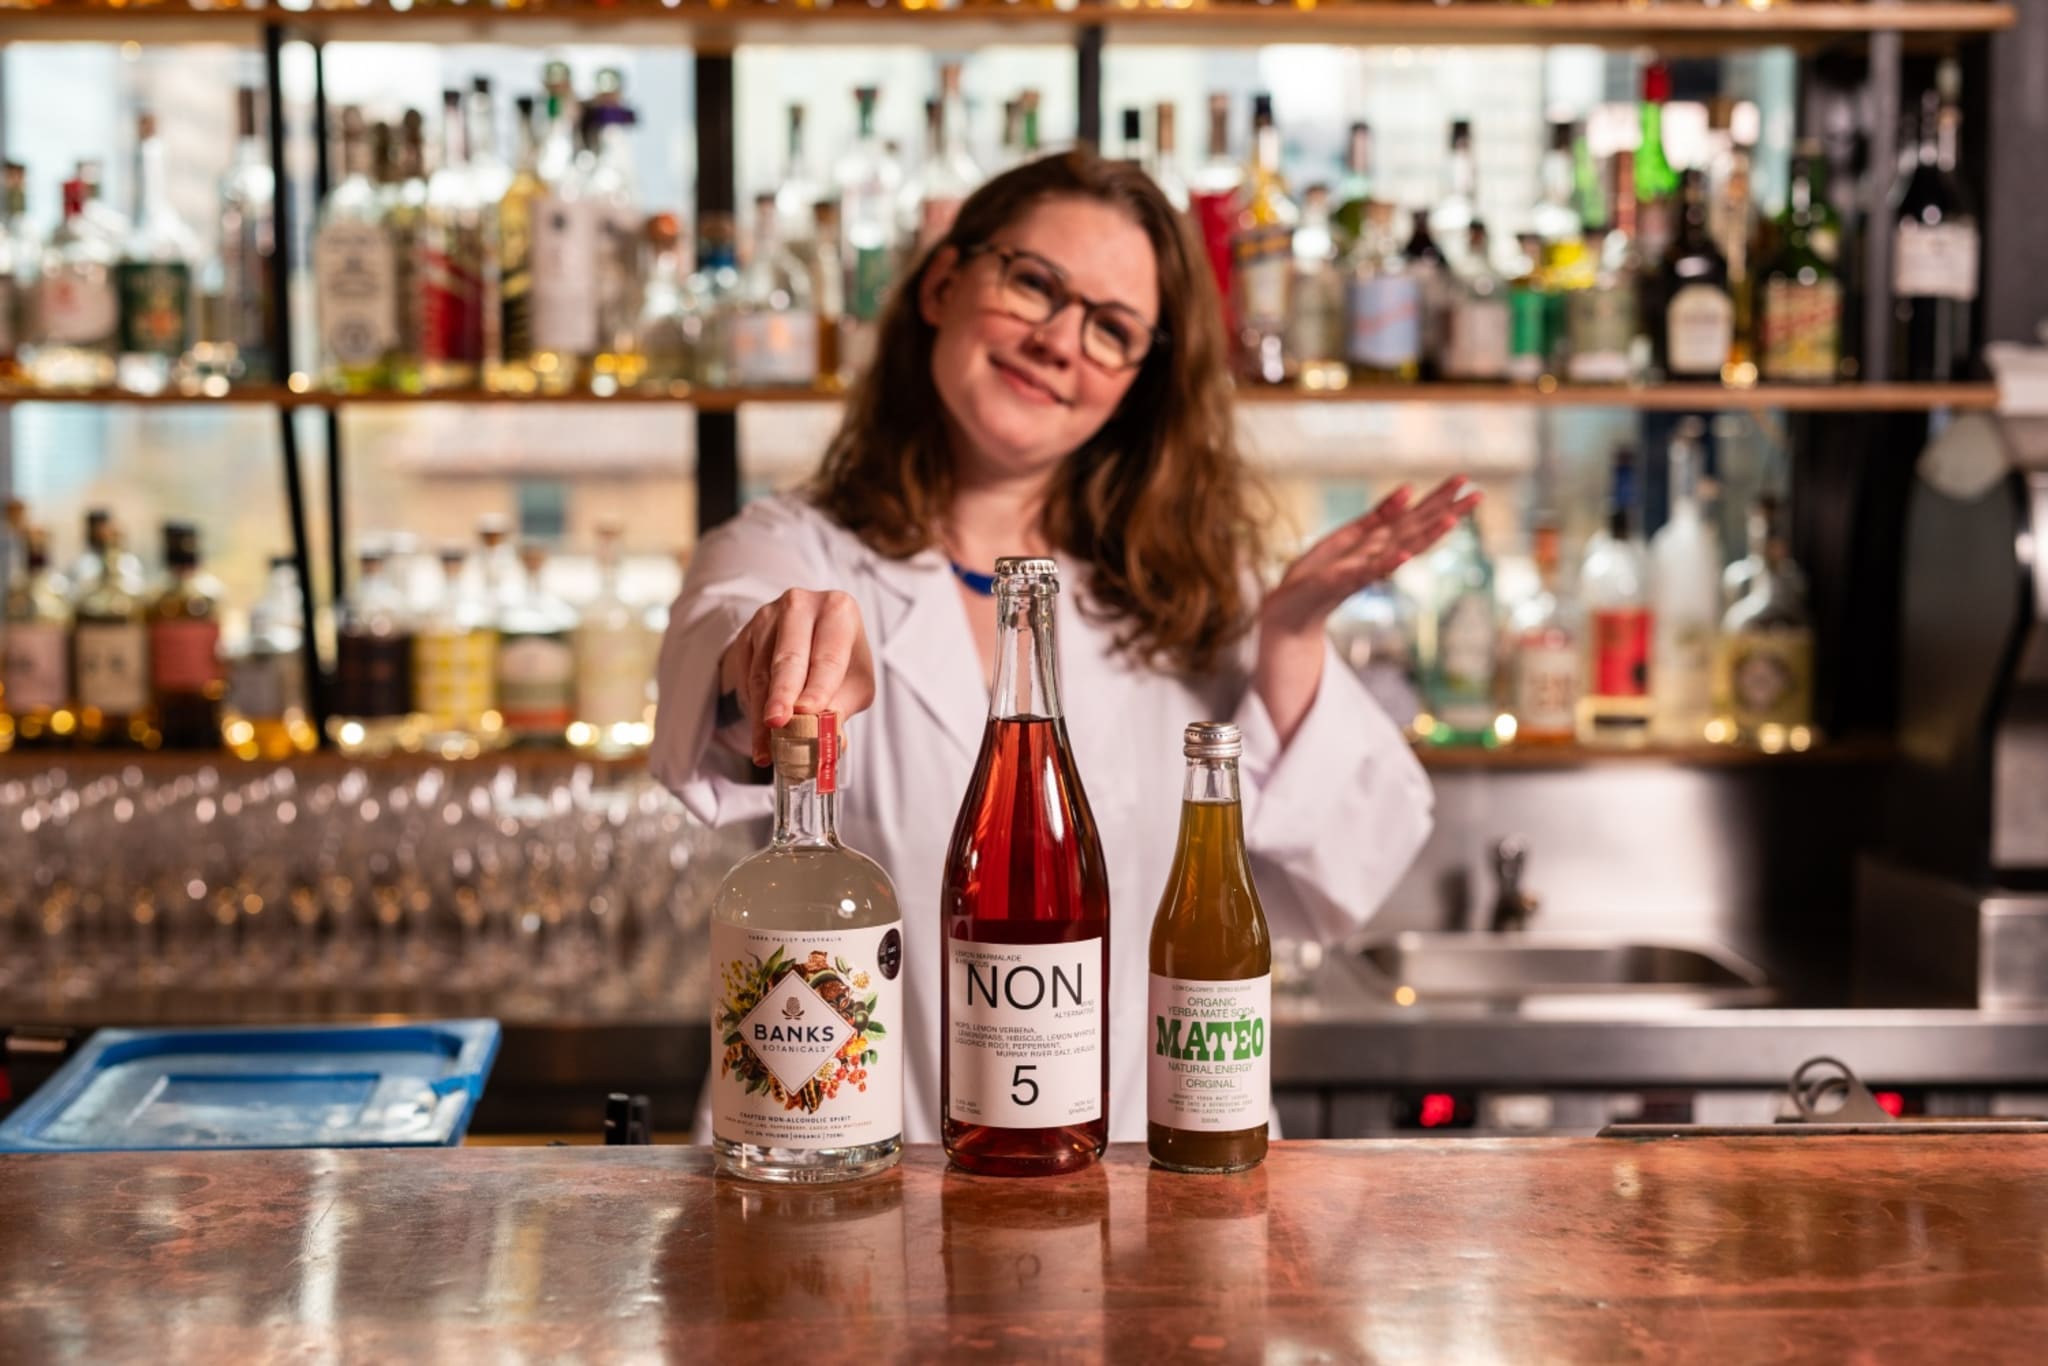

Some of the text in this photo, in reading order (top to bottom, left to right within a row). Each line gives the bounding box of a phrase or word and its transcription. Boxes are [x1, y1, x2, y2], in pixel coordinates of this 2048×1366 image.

[976, 953, 1022, 962] MARMALADE
[967, 962, 1082, 1010] NON
[1187, 996, 1237, 1007] ORGANIC
[1167, 1006, 1198, 1018] YERBA
[1200, 1008, 1228, 1018] MATE
[754, 1024, 834, 1042] BANKS
[972, 1024, 998, 1033] LEMON
[1046, 1032, 1072, 1041] LEMON
[1156, 1014, 1264, 1062] MATÉO
[996, 1050, 1028, 1058] MURRAY
[1030, 1049, 1052, 1057] RIVER
[1168, 1061, 1253, 1074] NATURAL ENERGY
[1011, 1064, 1039, 1106] 5
[1186, 1079, 1236, 1089] ORIGINAL
[739, 1111, 767, 1121] CRAFTED
[768, 1116, 827, 1124] NON-ALCOHOLIC
[830, 1115, 851, 1123] SPIRIT
